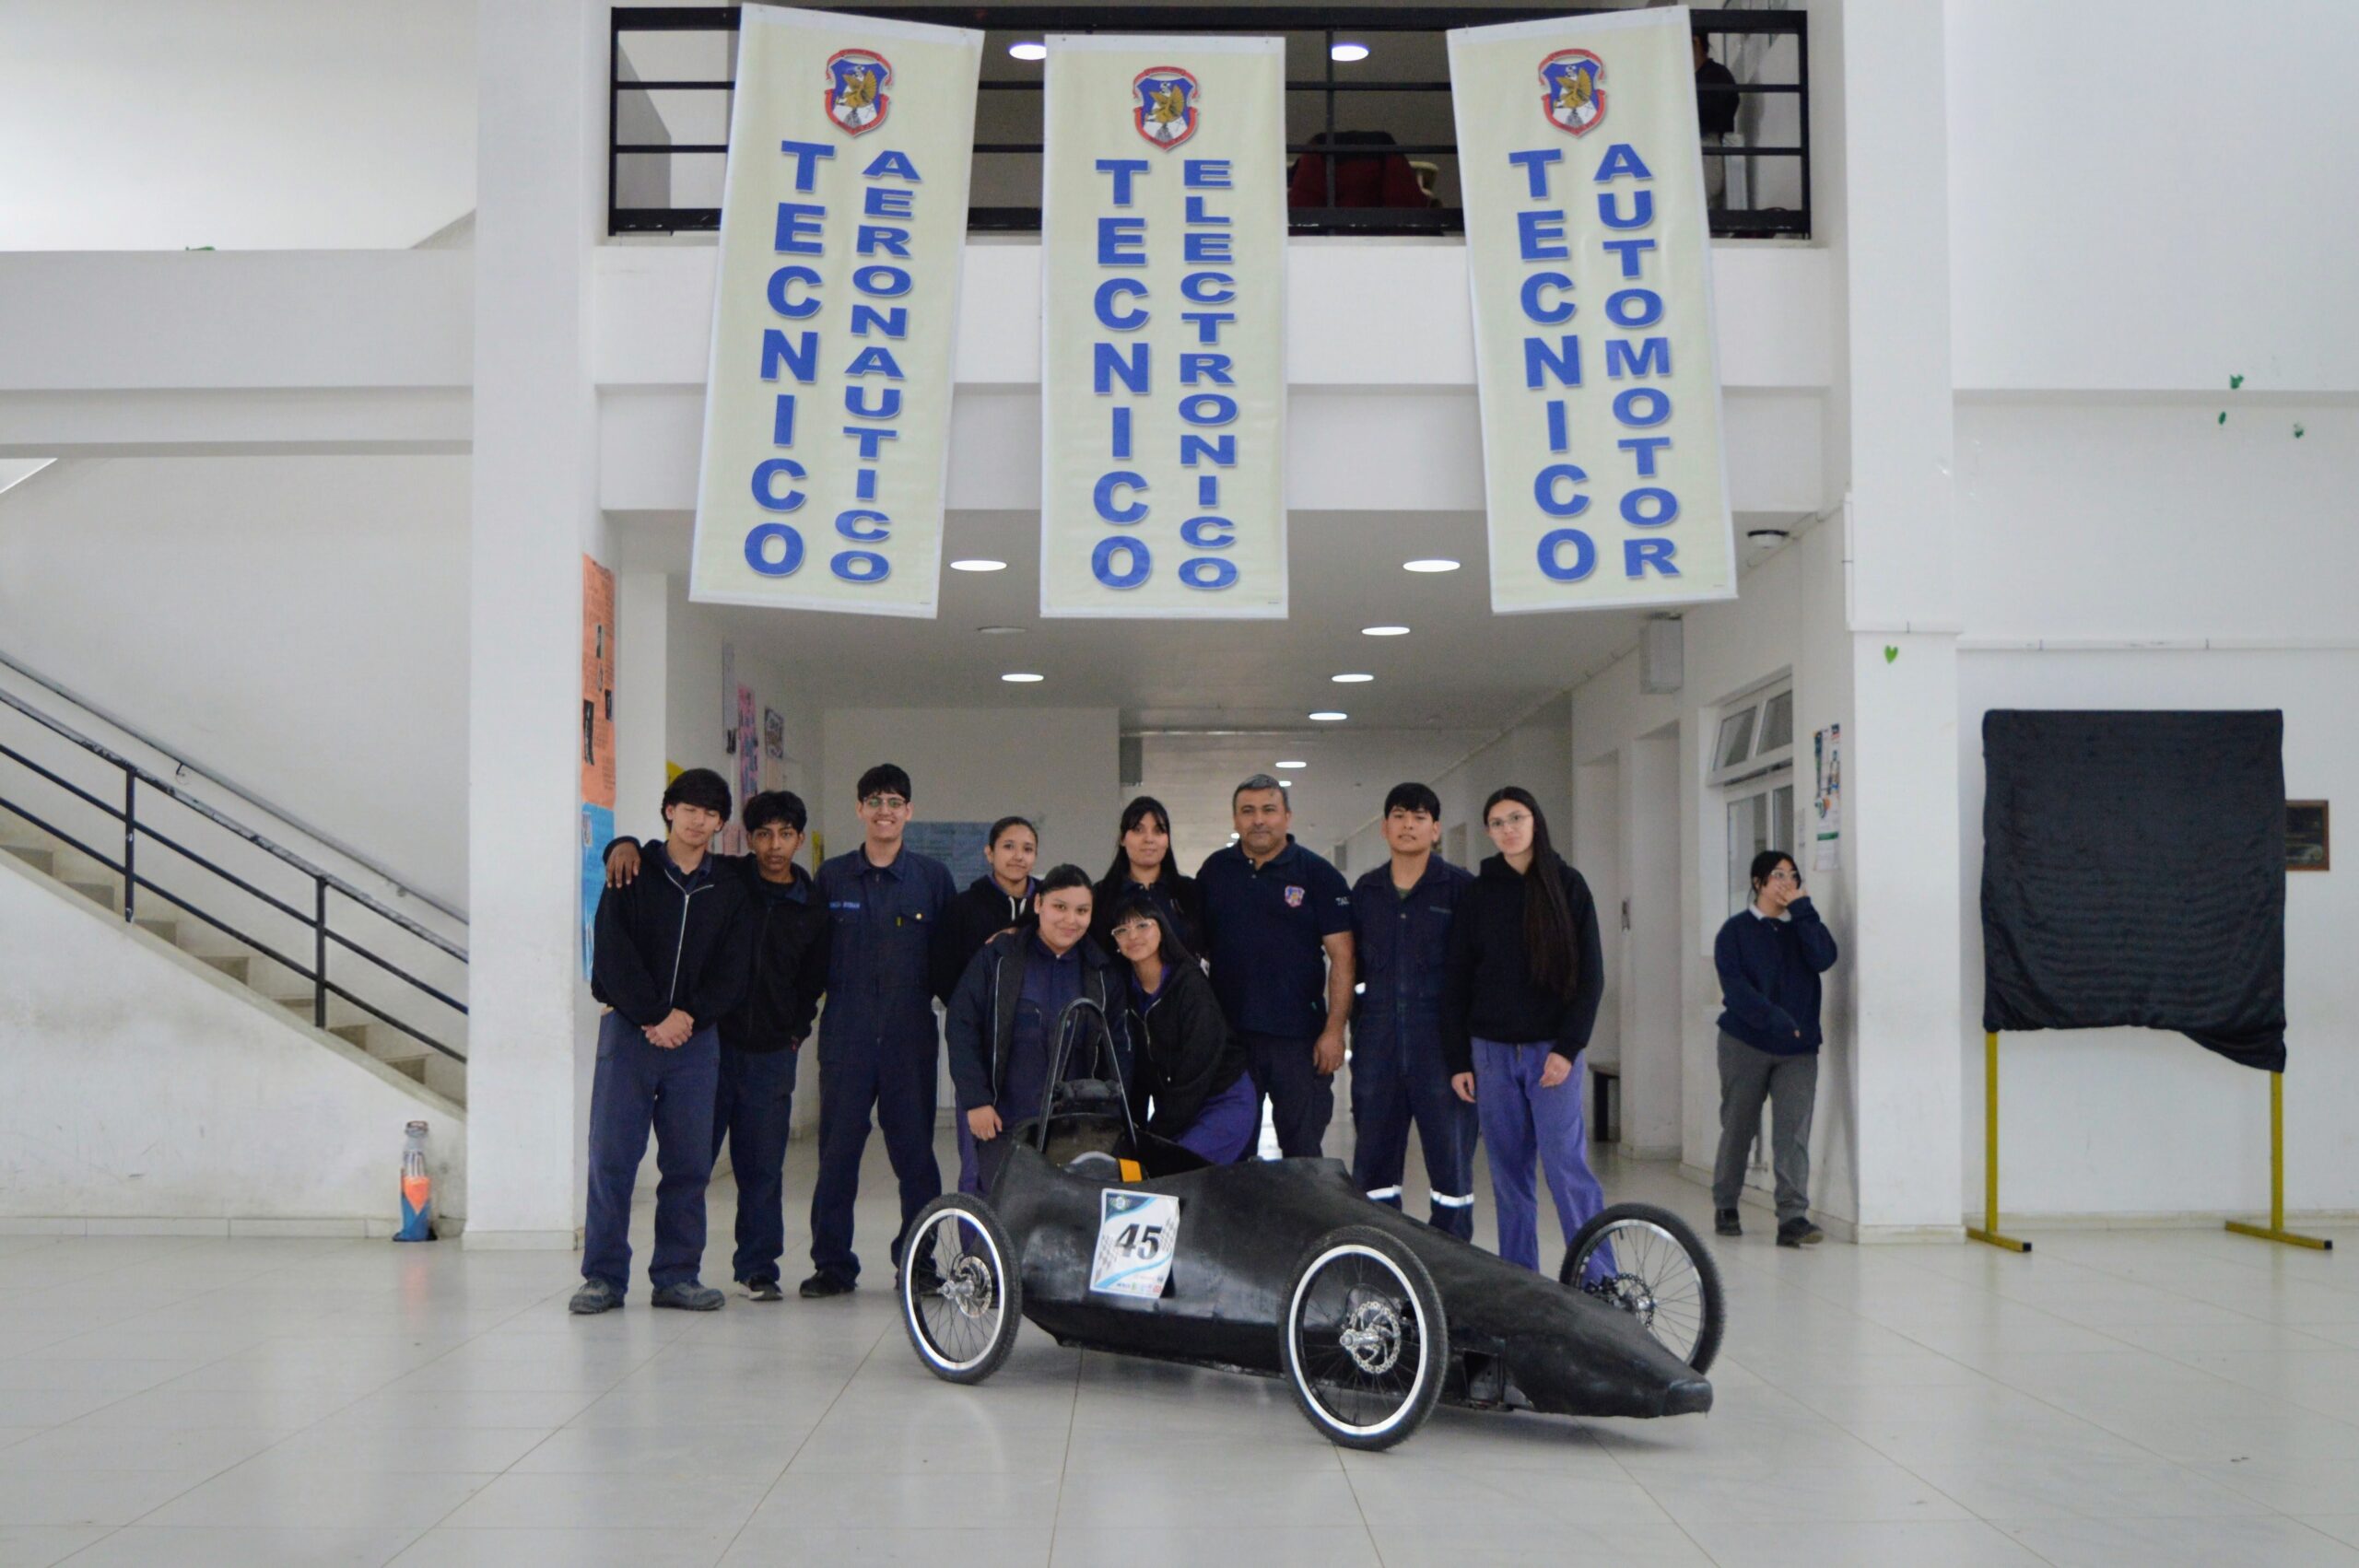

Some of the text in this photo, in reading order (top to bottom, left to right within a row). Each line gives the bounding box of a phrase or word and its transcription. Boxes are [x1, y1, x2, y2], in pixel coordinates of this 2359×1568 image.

[744, 140, 836, 577] TECNICO
[830, 149, 921, 583] AERONAUTICO
[1091, 158, 1151, 590] TECNICO
[1179, 158, 1238, 590] ELECTRONICO
[1508, 148, 1598, 582] TECNICO
[1593, 143, 1680, 578] AUTOMOTOR
[1114, 1223, 1162, 1260] 45
